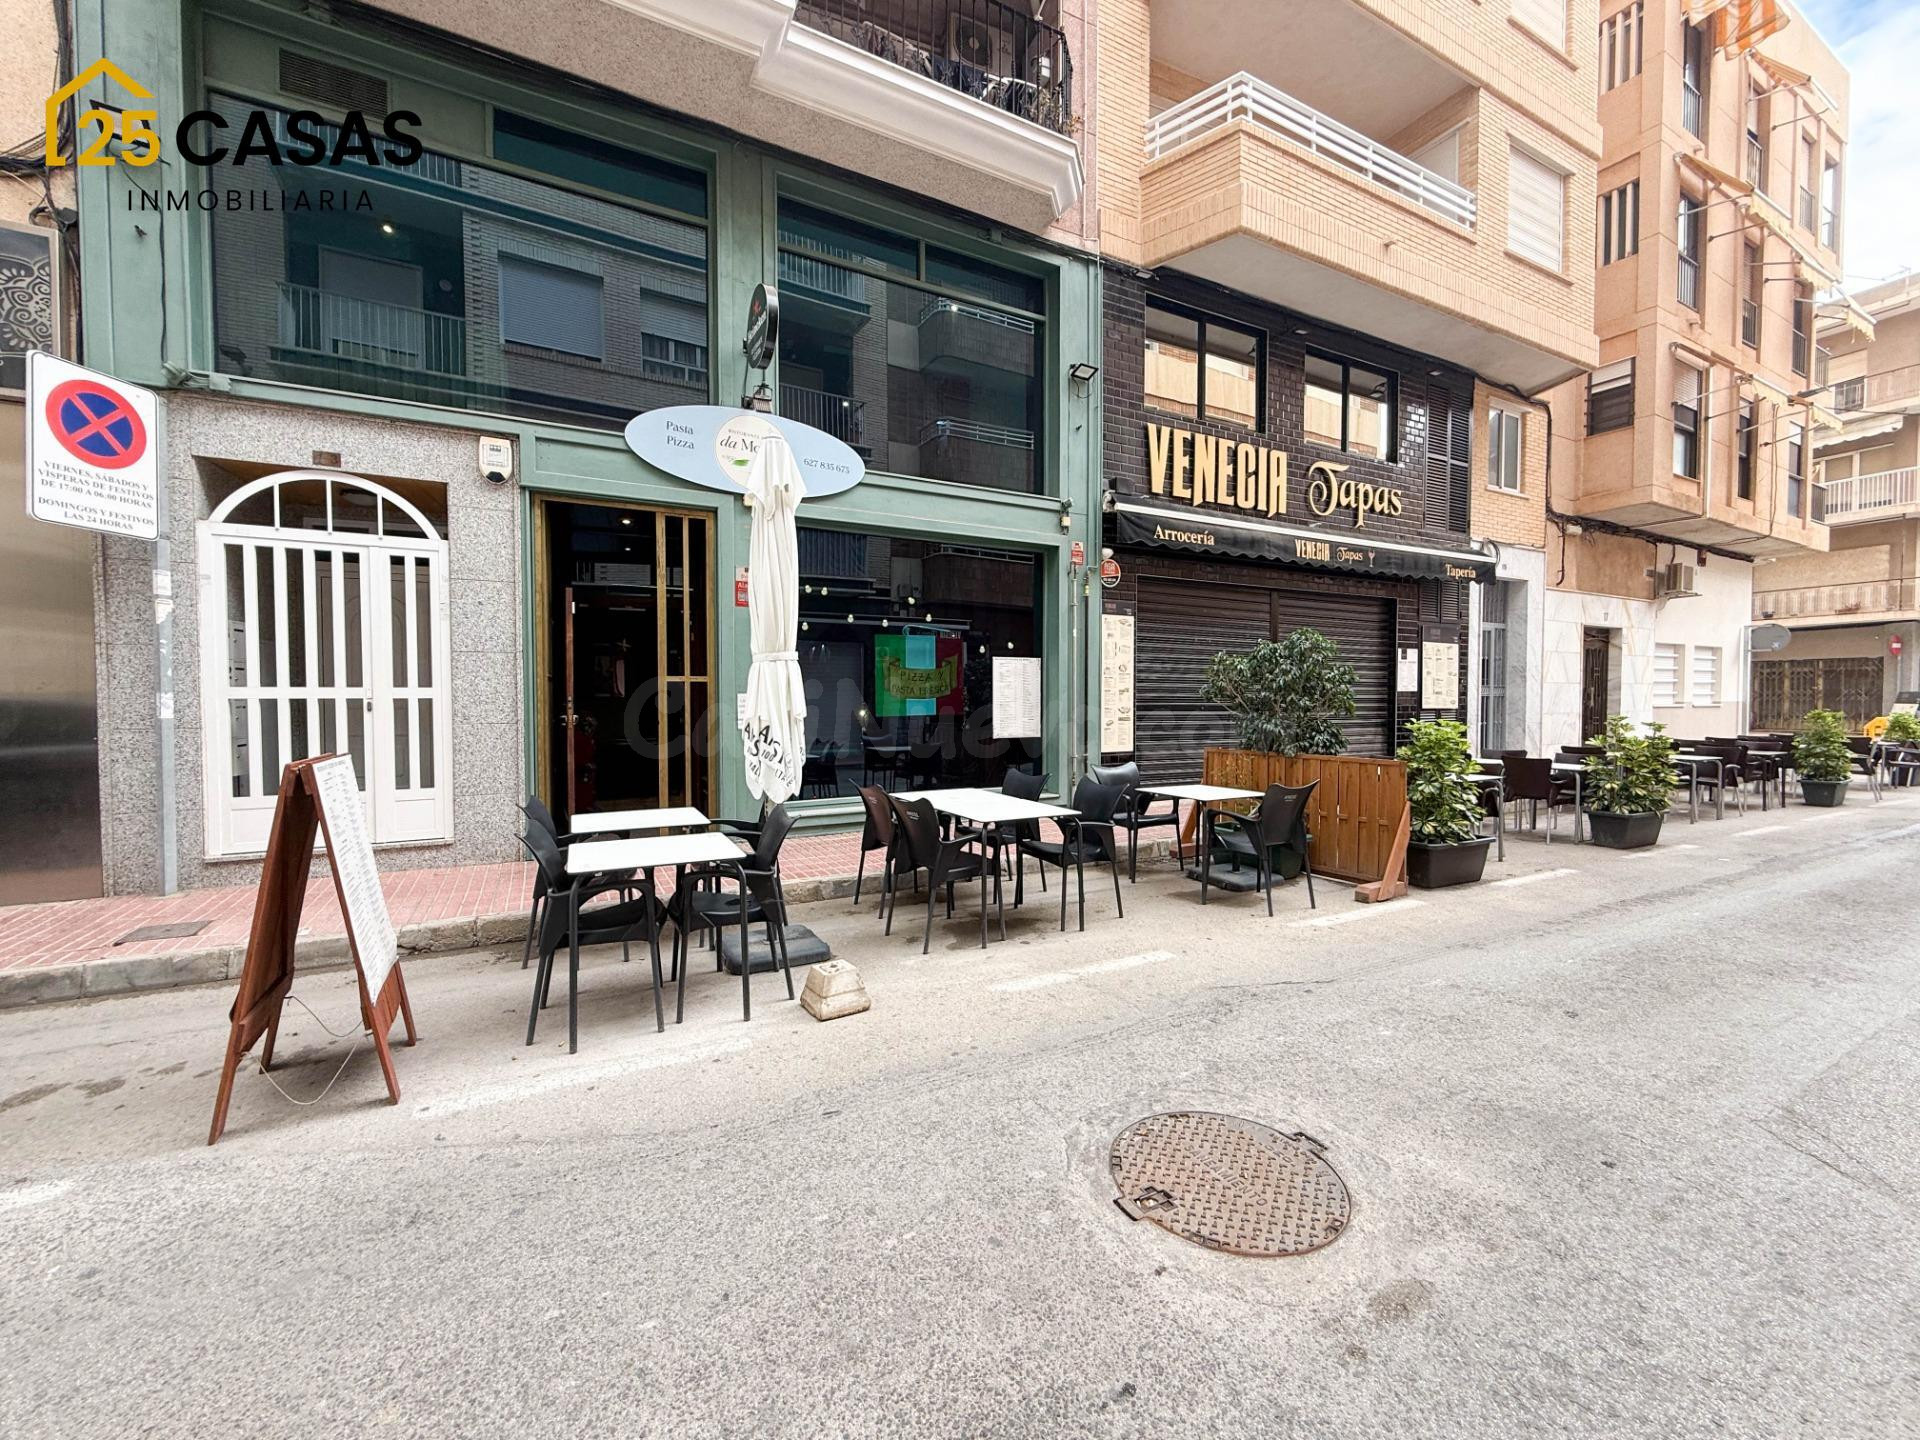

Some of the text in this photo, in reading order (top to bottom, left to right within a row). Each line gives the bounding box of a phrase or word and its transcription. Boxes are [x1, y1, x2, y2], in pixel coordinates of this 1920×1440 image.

[666, 420, 694, 435] Pasta
[667, 435, 695, 449] Pizza
[720, 435, 737, 449] da
[803, 458, 819, 468] 627
[1147, 422, 1402, 529] VENECIA Tapas
[41, 478, 56, 488] DE
[85, 488, 92, 496] A
[119, 495, 152, 509] HORAS
[92, 481, 104, 490] DE
[109, 484, 154, 501] FESTIVOS
[38, 497, 154, 526] DOMINGOS Y FESTIVOS
[64, 511, 134, 530] LAS 24 HORAS
[1154, 523, 1215, 546] Arrocería
[1295, 539, 1364, 565] VENECIA Tapas
[1445, 563, 1476, 580] Tapería
[900, 670, 933, 682] PIZZA
